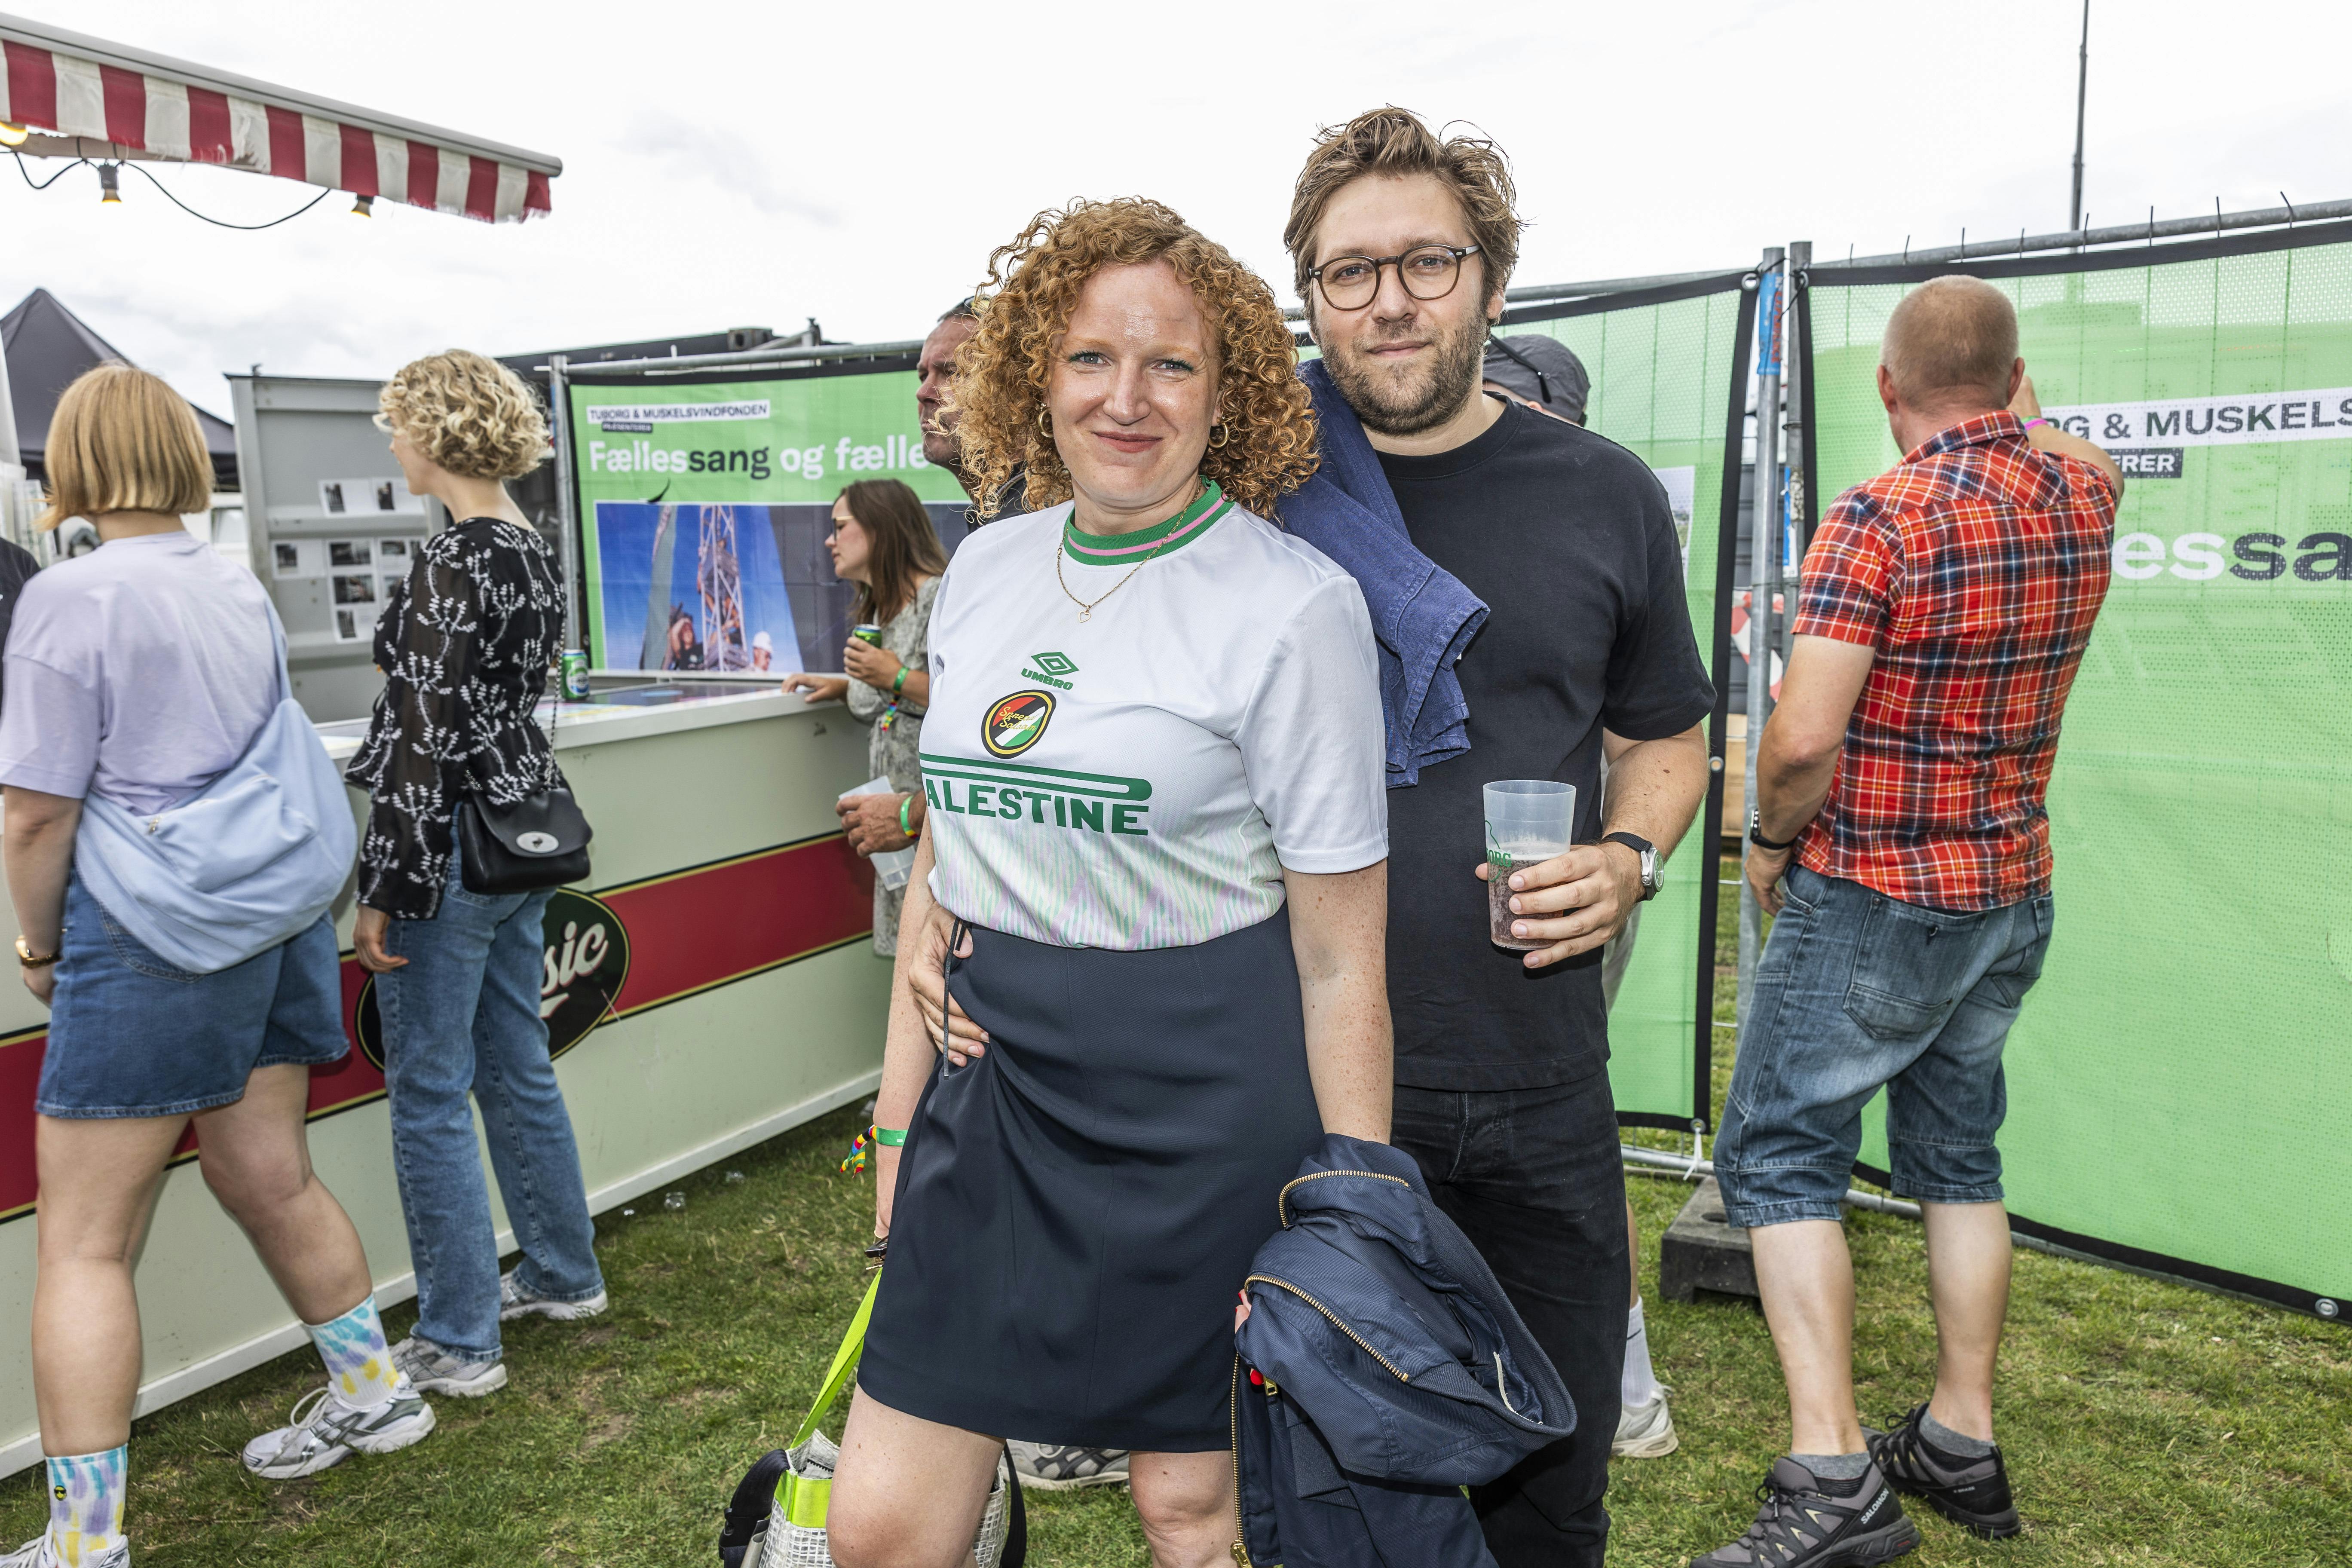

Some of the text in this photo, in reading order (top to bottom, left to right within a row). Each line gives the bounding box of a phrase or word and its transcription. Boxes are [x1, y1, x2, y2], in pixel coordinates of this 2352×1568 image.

[590, 403, 768, 420] TUBORG & MUSKELSVINDFONDEN
[2103, 413, 2131, 439] &
[589, 440, 771, 480] Fællessang
[779, 444, 826, 480] og
[1021, 668, 1074, 690] UMBRO
[999, 706, 1039, 721] Spread
[999, 717, 1036, 731] Salaam
[1860, 1488, 1890, 1525] SALOMON
